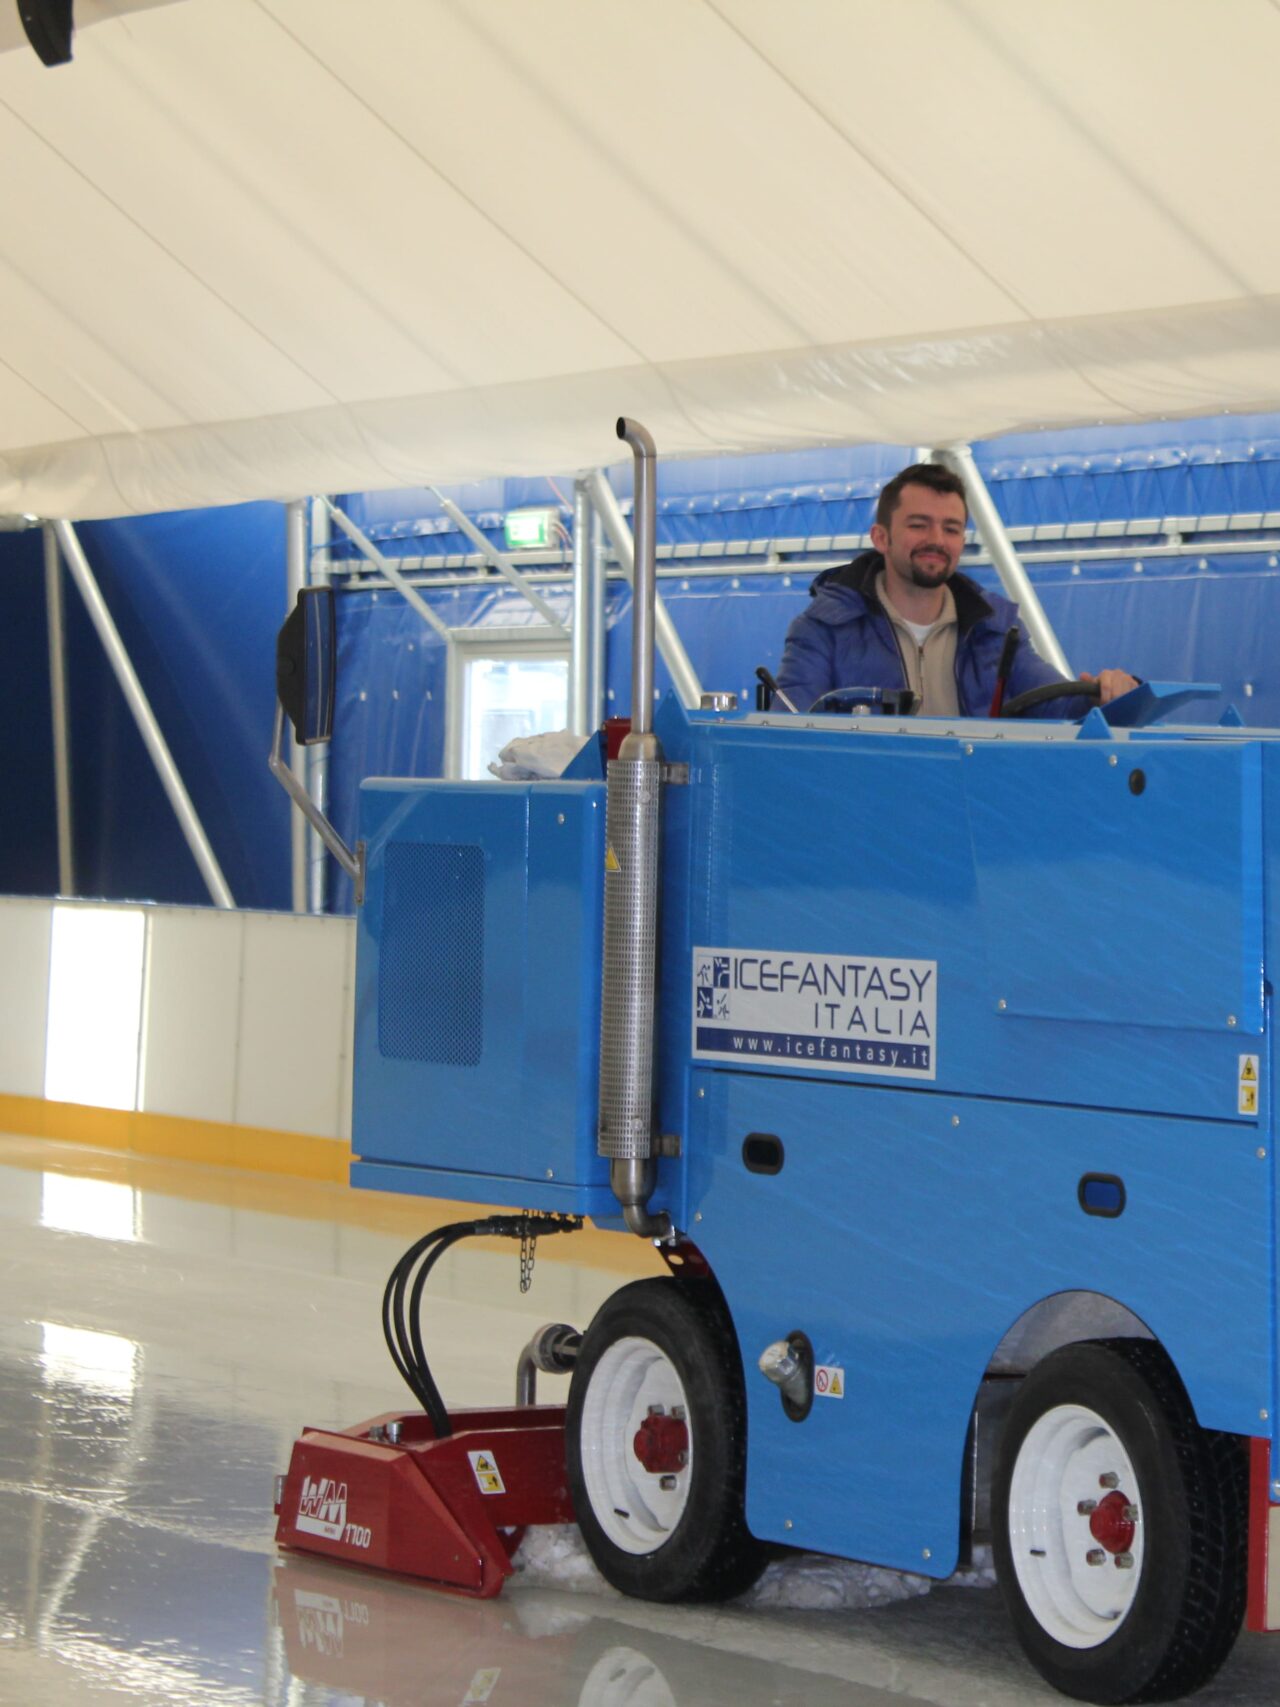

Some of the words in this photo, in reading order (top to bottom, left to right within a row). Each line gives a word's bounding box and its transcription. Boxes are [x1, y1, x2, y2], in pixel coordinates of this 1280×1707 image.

[734, 957, 932, 1003] ICEFANTASY
[814, 1002, 931, 1039] ITALIA
[733, 1036, 928, 1068] www.icefantasy.it
